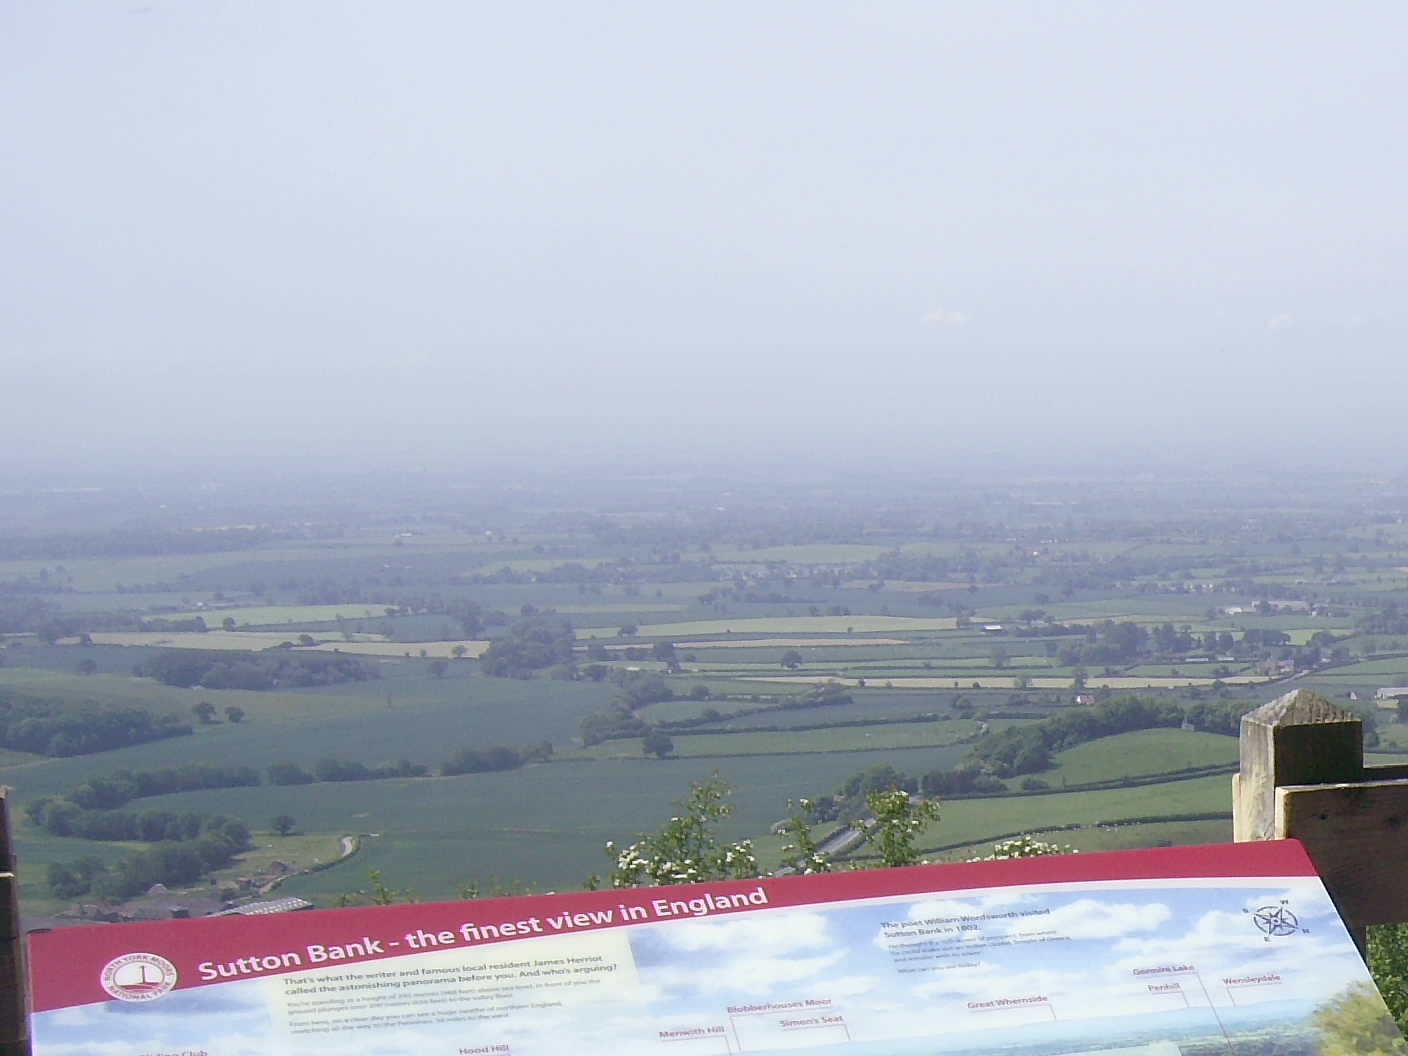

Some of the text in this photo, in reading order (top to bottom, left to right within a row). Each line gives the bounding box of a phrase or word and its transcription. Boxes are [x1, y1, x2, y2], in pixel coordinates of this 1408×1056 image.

[198, 951, 301, 980] Sutton
[306, 937, 384, 962] Bank
[405, 929, 455, 949] the
[460, 916, 543, 942] finest
[546, 908, 613, 930] view
[618, 904, 647, 921] in
[652, 887, 768, 916] England
[918, 928, 942, 936] Bank
[926, 916, 960, 926] William
[283, 976, 314, 985] That's
[317, 974, 343, 983] what
[346, 973, 363, 981] the
[366, 971, 396, 980] writer
[399, 968, 419, 976] and
[421, 966, 460, 975] famous
[462, 963, 487, 972] local
[489, 960, 531, 969] resident
[534, 959, 564, 967] James
[285, 987, 316, 995] called
[319, 985, 337, 993] the
[339, 980, 400, 992] astonishing
[402, 977, 456, 988] panorama
[459, 973, 491, 983] before
[519, 970, 540, 978] And
